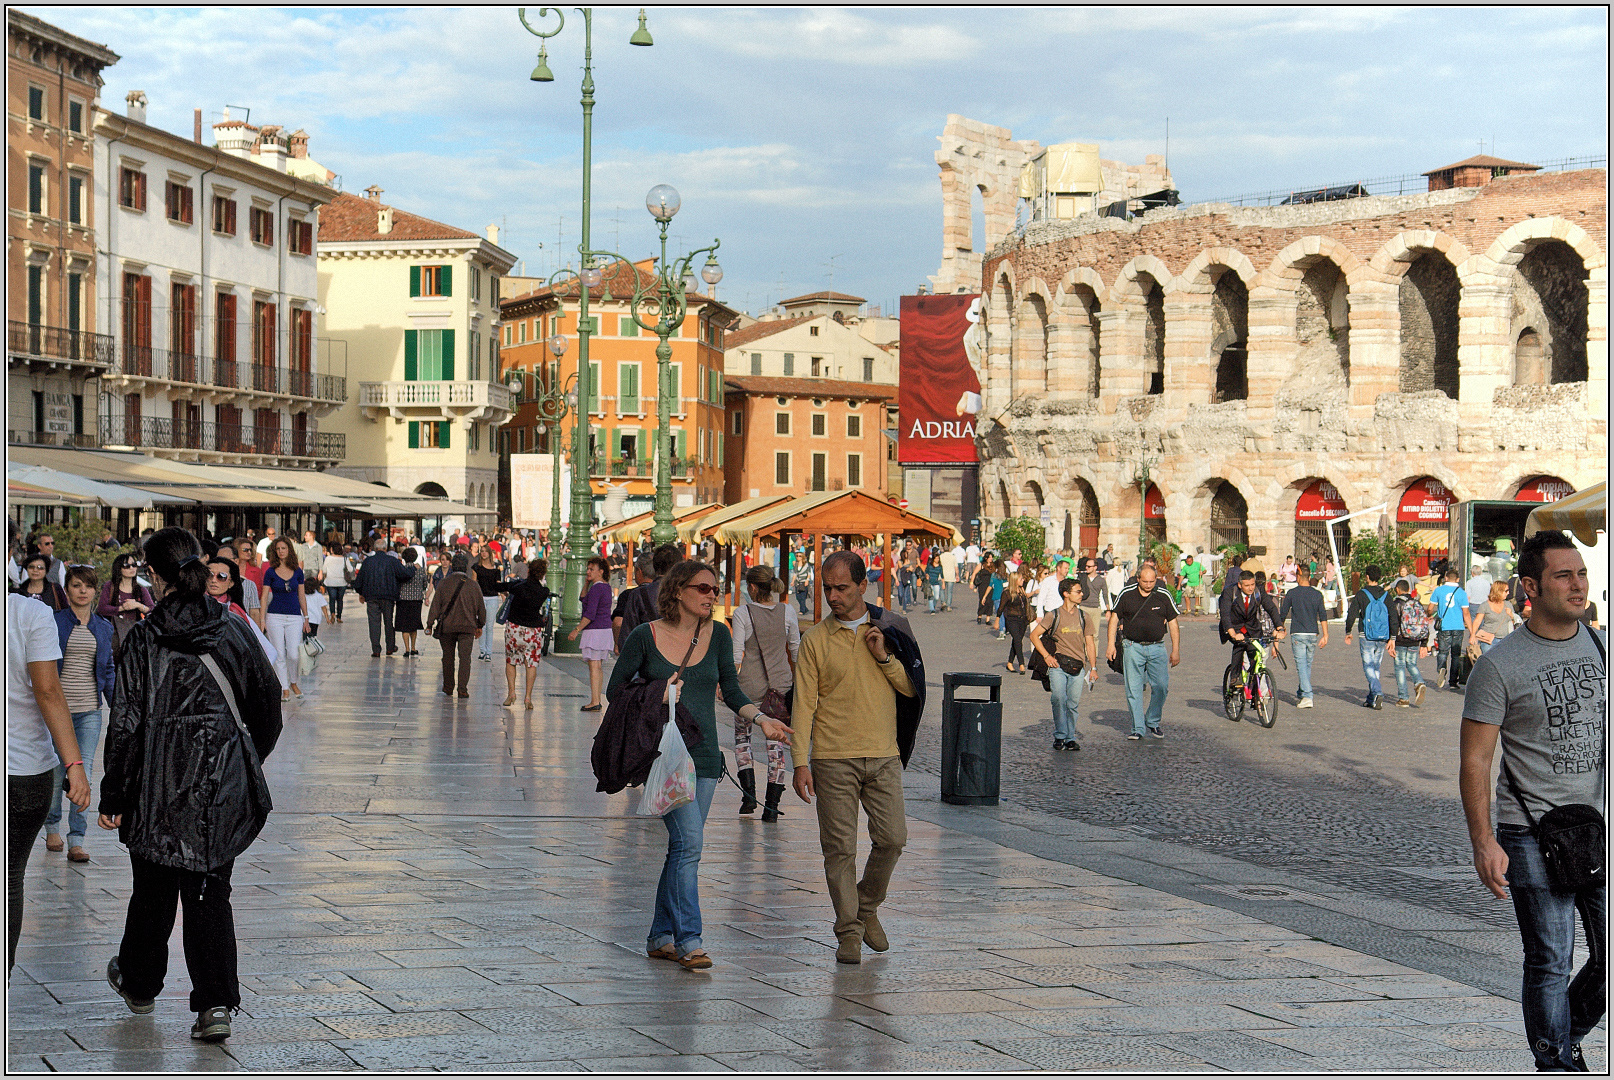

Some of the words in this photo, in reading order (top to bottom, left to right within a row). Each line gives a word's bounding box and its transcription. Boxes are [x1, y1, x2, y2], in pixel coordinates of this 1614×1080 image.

[908, 418, 976, 439] ADRIA
[1429, 487, 1446, 496] LOVE
[1536, 482, 1575, 494] ADRIANO
[1446, 497, 1451, 506] 7
[1320, 505, 1326, 517] 6
[1542, 677, 1606, 707] MUST
[1547, 701, 1582, 727] BE
[1548, 725, 1583, 741] LIKE
[1551, 741, 1592, 754] CRASH
[1552, 752, 1581, 762] CRAZY
[1552, 757, 1601, 775] CREW
